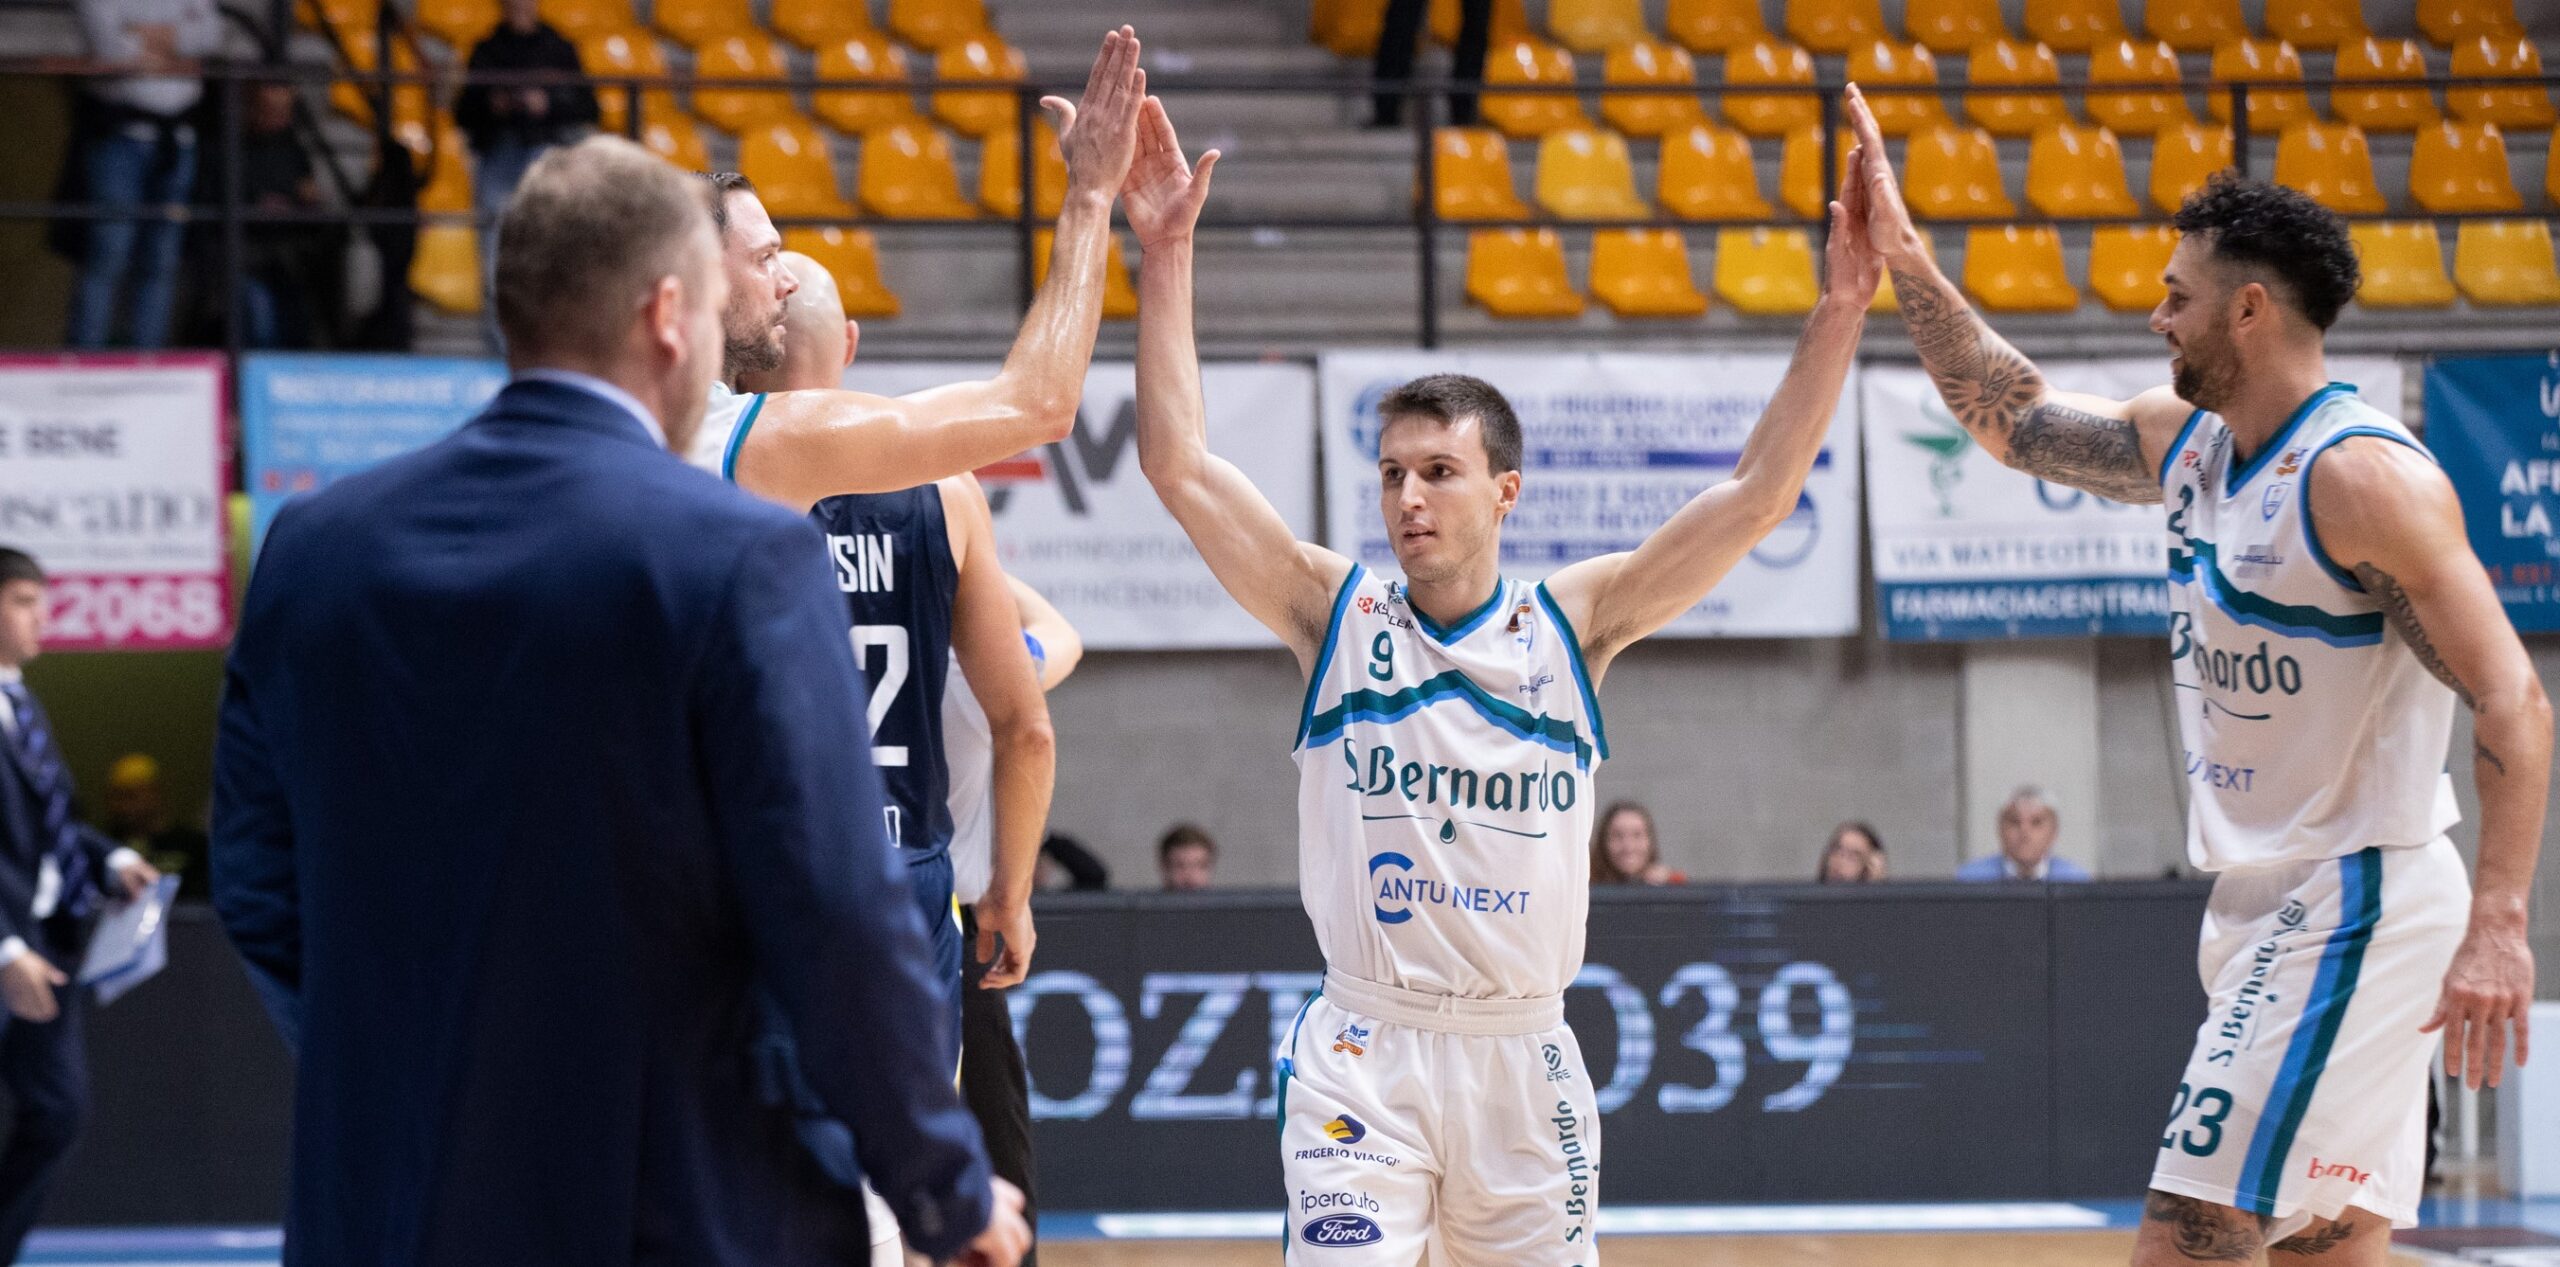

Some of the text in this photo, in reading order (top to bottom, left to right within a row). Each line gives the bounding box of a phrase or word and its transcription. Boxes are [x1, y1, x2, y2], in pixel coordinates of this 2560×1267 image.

[827, 533, 894, 592] SIN
[1368, 631, 1394, 681] 9
[1452, 886, 1530, 914] NEXT
[1295, 1147, 1397, 1168] FRIGERIO VIAGGI
[1300, 1189, 1380, 1215] iperauto
[1317, 1219, 1372, 1242] Ford
